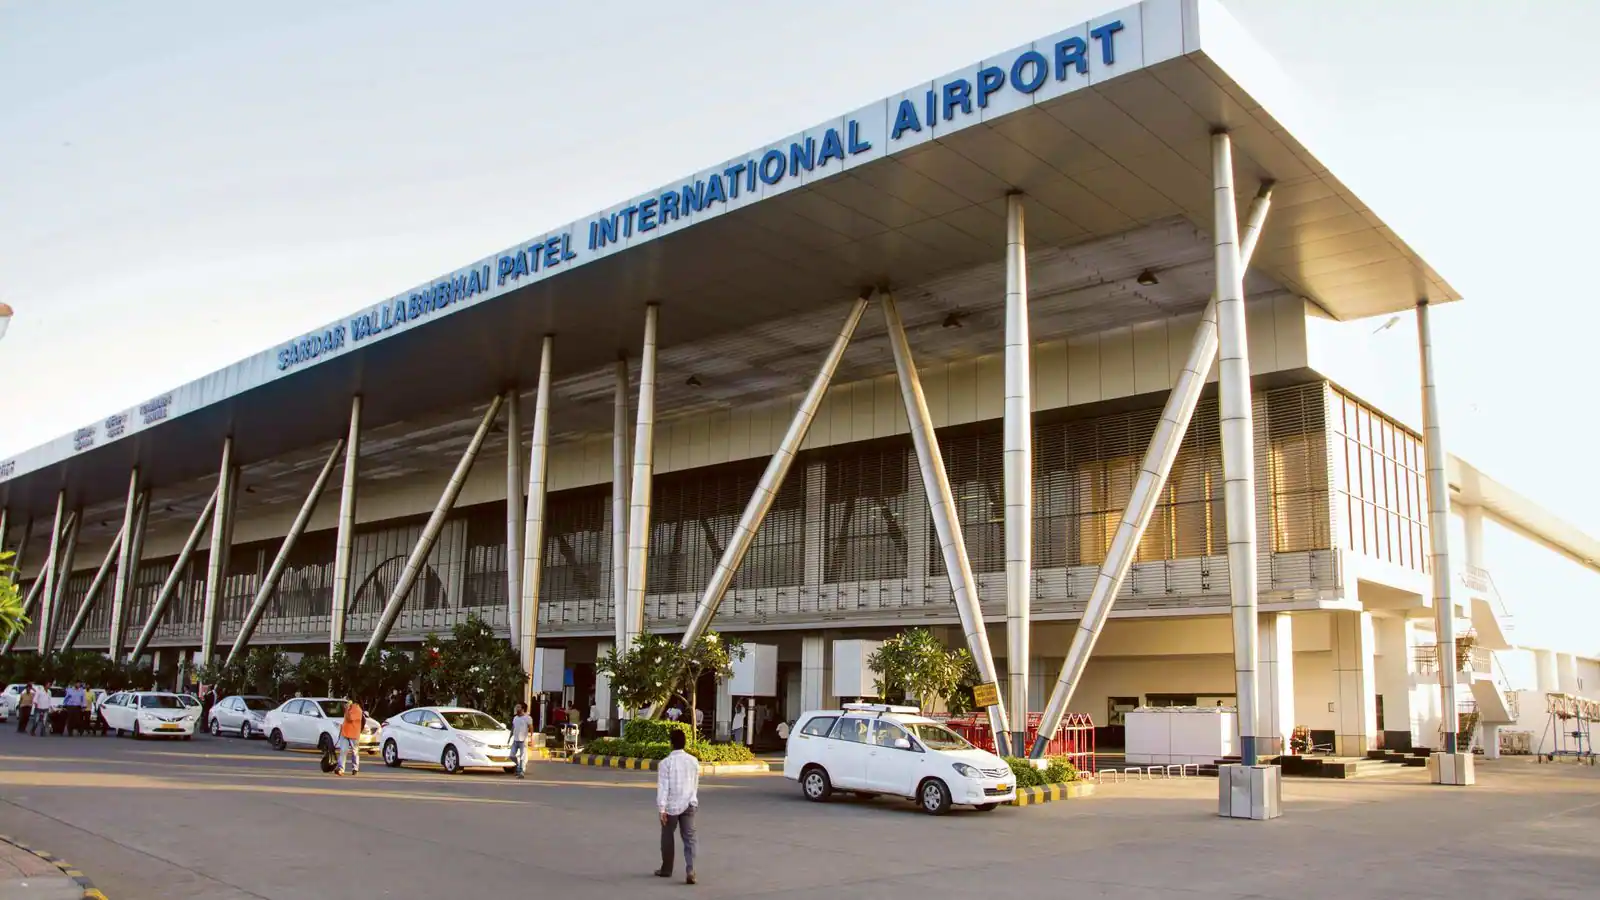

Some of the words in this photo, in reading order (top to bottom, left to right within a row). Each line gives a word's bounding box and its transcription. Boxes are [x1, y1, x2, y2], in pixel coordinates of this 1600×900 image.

[277, 325, 345, 371] SARDAR
[351, 265, 490, 341] VALLABHBHAI
[498, 232, 577, 286] PATEL
[588, 119, 871, 251] INTERNATIONAL
[891, 20, 1124, 140] AIRPORT
